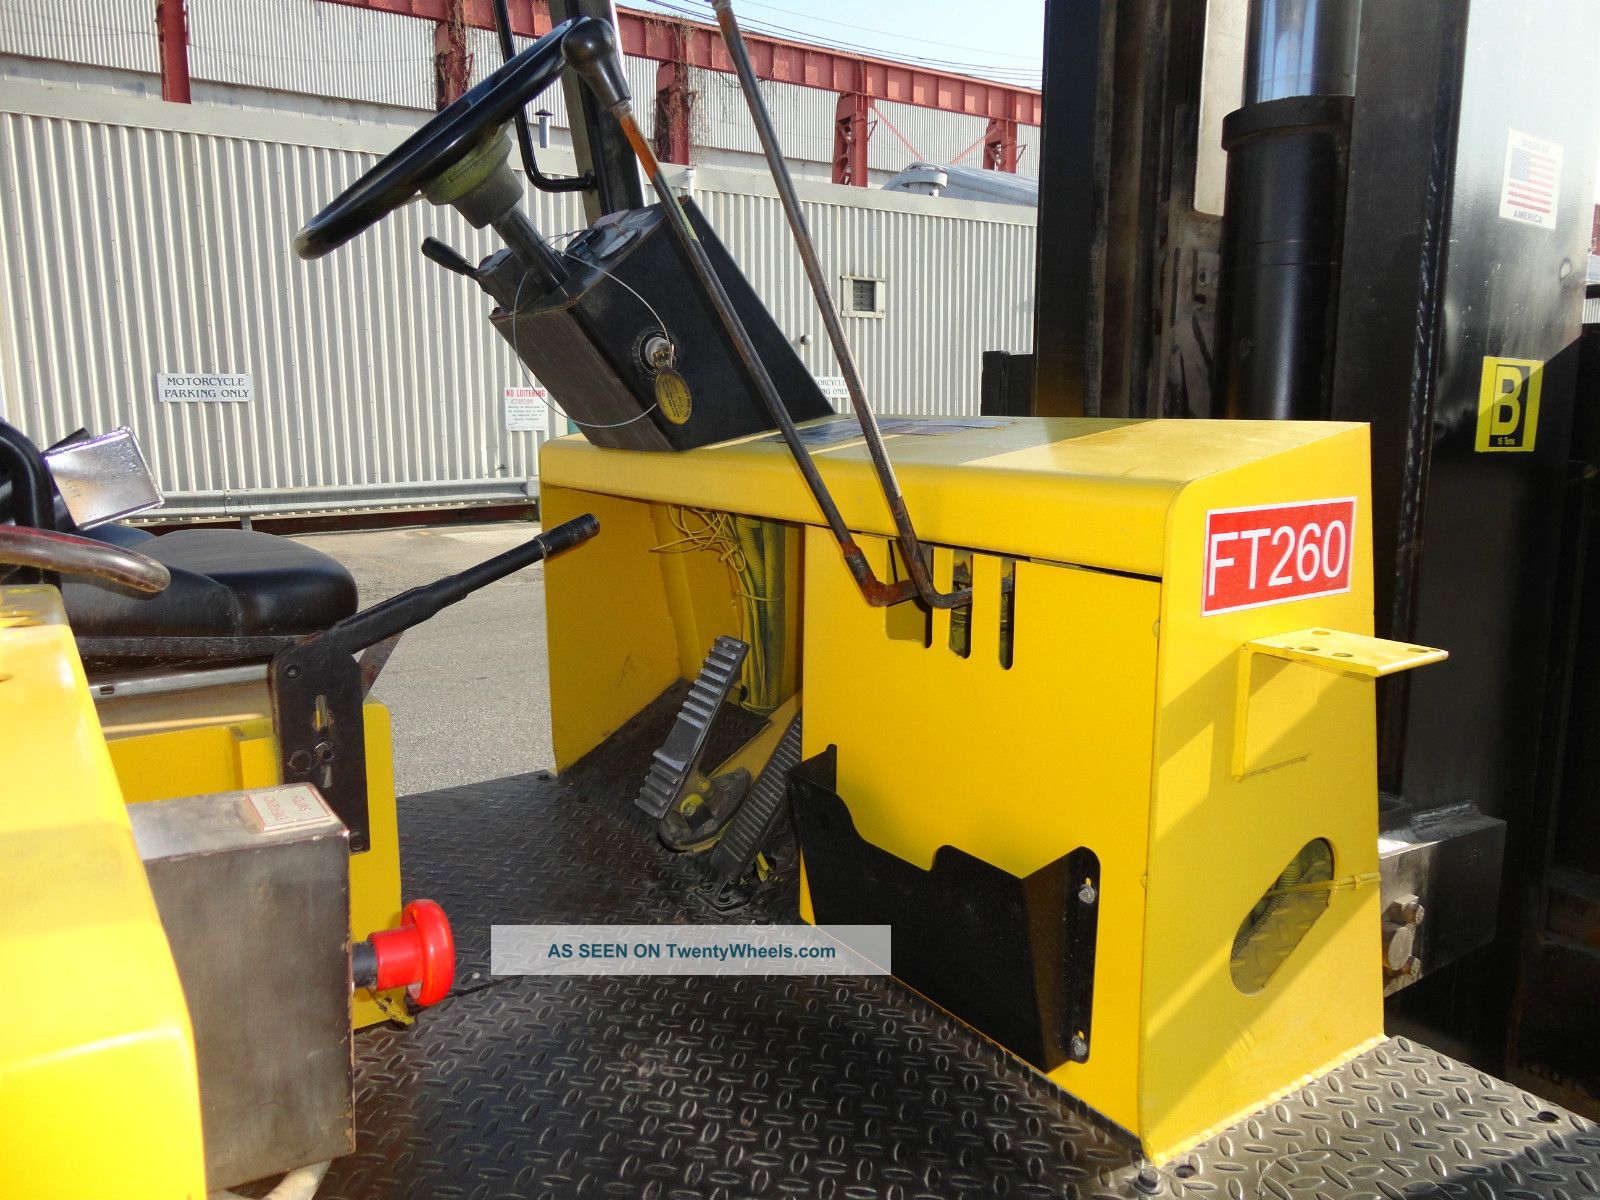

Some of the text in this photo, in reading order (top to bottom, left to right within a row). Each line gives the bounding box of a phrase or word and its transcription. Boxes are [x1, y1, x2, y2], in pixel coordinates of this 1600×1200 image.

[164, 389, 249, 398] PARKING ONLY
[167, 377, 245, 386] MOTORCYCLE
[1490, 366, 1522, 435] B
[1208, 520, 1346, 596] FT260
